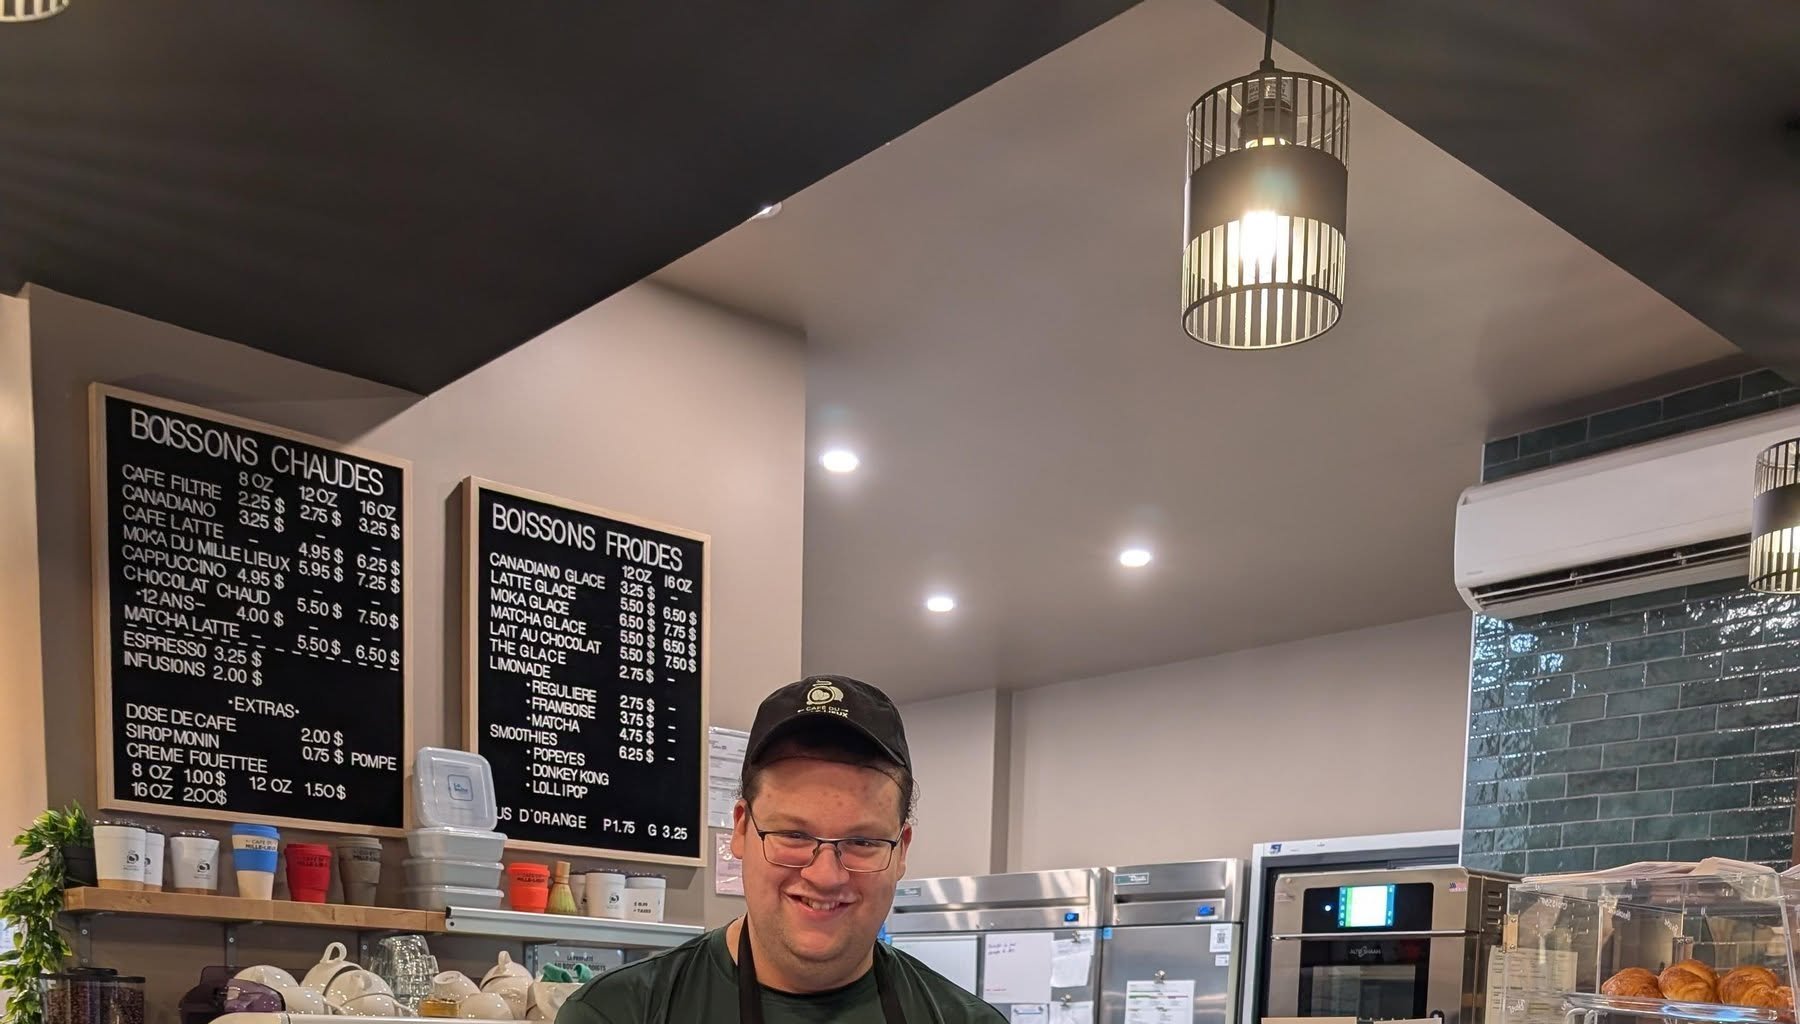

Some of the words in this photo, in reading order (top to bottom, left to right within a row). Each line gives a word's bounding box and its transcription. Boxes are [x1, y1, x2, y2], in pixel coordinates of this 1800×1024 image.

[131, 408, 257, 465] BOISSONS
[271, 445, 383, 495] CHAUDES
[122, 464, 164, 487] CAFE
[171, 474, 221, 500] FILTRE
[239, 471, 248, 486] 8
[252, 473, 273, 492] OZ
[298, 485, 315, 502] 12
[316, 488, 337, 507] OZ
[359, 499, 375, 515] 16
[376, 503, 396, 521] OZ
[122, 484, 215, 517] CANADIANO
[123, 504, 165, 527] CAFE
[170, 514, 223, 539] LATTE
[123, 524, 167, 546] MOKA
[171, 534, 193, 551] DU
[492, 502, 595, 550] BOISSONS
[606, 530, 682, 571] FROIDES
[122, 544, 226, 577] CAPPUCCINO
[489, 552, 560, 579] CANADIANO
[564, 568, 605, 589] GLACE
[123, 564, 209, 593] CHOCOLAT
[216, 582, 270, 605] CHAUD
[490, 569, 531, 590] LATTE
[534, 578, 576, 599] GLACE
[621, 565, 634, 579] 12
[635, 568, 652, 583] OZ
[664, 574, 675, 588] 16
[676, 577, 692, 593] OZ
[490, 586, 526, 606] MOKA
[528, 594, 569, 615] GLACE
[124, 604, 188, 629] MATCHA
[192, 616, 239, 638] LATTE
[490, 603, 541, 626] MATCHA
[543, 614, 586, 635] GLACE
[123, 630, 206, 658] ESPRESSO
[489, 637, 515, 655] THE
[519, 644, 566, 664] GLACE
[490, 621, 518, 638] LAIT
[519, 627, 538, 642] AU
[539, 630, 601, 654] CHOCOLAT
[124, 650, 205, 677] INFUSIONS
[489, 655, 550, 678] LIMONADE
[532, 679, 596, 703] REGULIERE
[126, 703, 168, 723] DOSE
[171, 708, 193, 726] DE
[194, 712, 236, 732] CAFE
[531, 696, 595, 719] FRAMBOISE
[489, 723, 557, 745] SMOOTHIES
[531, 713, 580, 732] MATCHA
[125, 722, 172, 741] SIROP
[173, 729, 219, 748] MONIN
[351, 751, 396, 770] POMPE
[126, 742, 183, 763] CREME
[189, 749, 267, 773] FOUETTEE
[533, 746, 585, 766] POPEYES
[131, 762, 142, 777] 8
[148, 764, 173, 780] OZ
[248, 775, 266, 790] 12
[270, 778, 292, 793] OZ
[532, 763, 578, 781] DONKEY
[579, 769, 609, 785] KONG
[131, 781, 147, 796] 16
[149, 783, 173, 799] OZ
[533, 780, 588, 798] LOLLIPOP
[647, 823, 656, 836] G
[662, 824, 687, 840] 3.25
